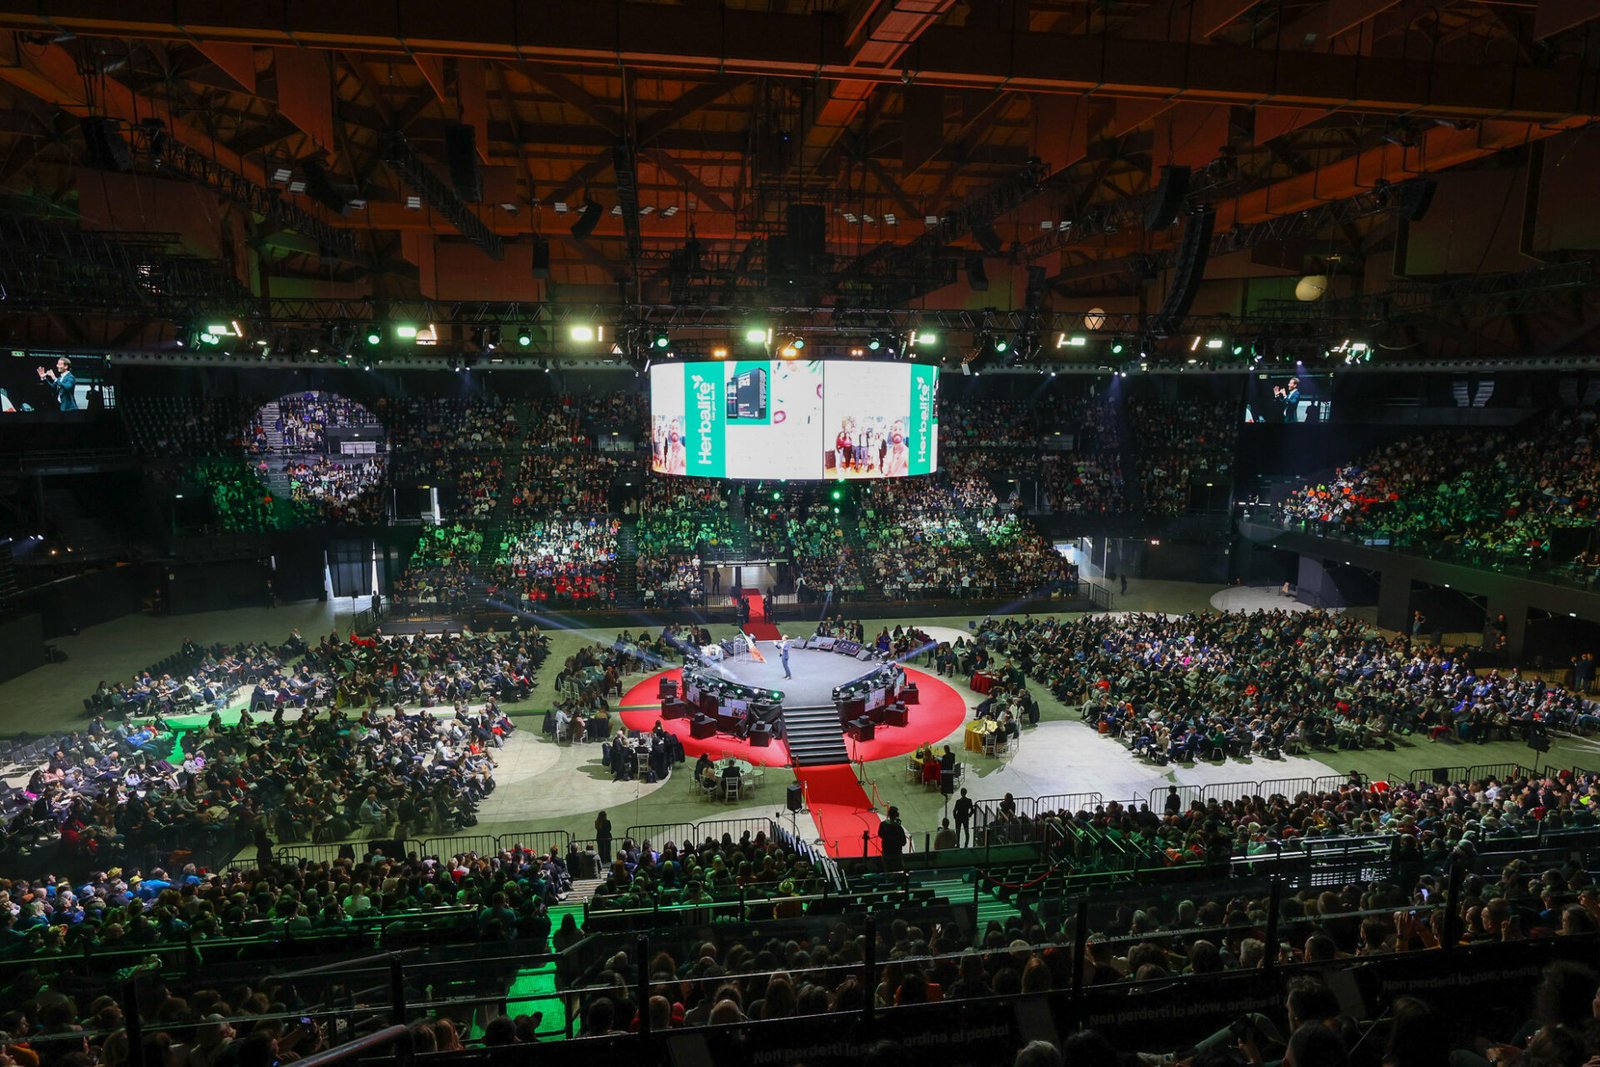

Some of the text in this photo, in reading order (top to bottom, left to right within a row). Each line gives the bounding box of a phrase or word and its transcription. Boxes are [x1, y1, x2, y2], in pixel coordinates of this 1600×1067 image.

[697, 382, 712, 465] Herbalife
[917, 384, 928, 463] Herbalife
[840, 642, 858, 651] 12:15
[1458, 972, 1472, 986] lo
[1089, 1013, 1115, 1025] Non
[1117, 1005, 1170, 1025] perderti
[1172, 1005, 1185, 1017] lo
[951, 1029, 964, 1042] al
[752, 1047, 782, 1064] Non
